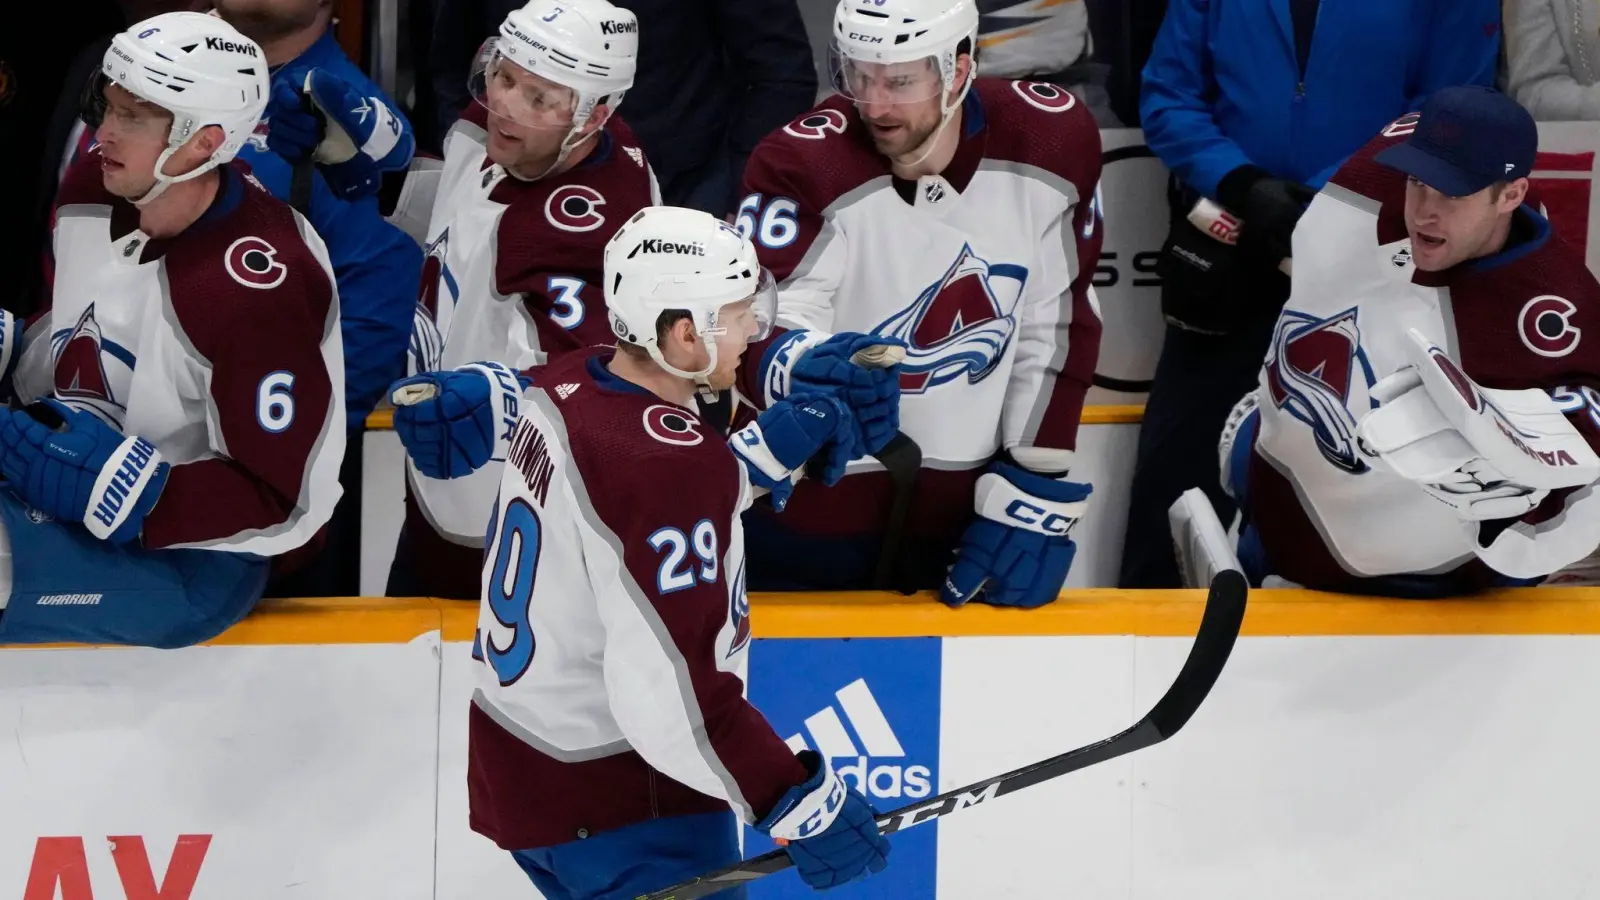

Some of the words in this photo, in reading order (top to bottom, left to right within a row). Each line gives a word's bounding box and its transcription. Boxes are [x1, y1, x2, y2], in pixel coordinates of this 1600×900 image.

[205, 36, 258, 58] Kiewit
[513, 30, 548, 52] BAUER
[849, 32, 884, 44] CCM
[642, 239, 706, 257] Kiewit
[548, 276, 587, 331] 3
[255, 370, 297, 433] 6
[646, 519, 719, 595] 29
[36, 593, 104, 605] WARRIOR
